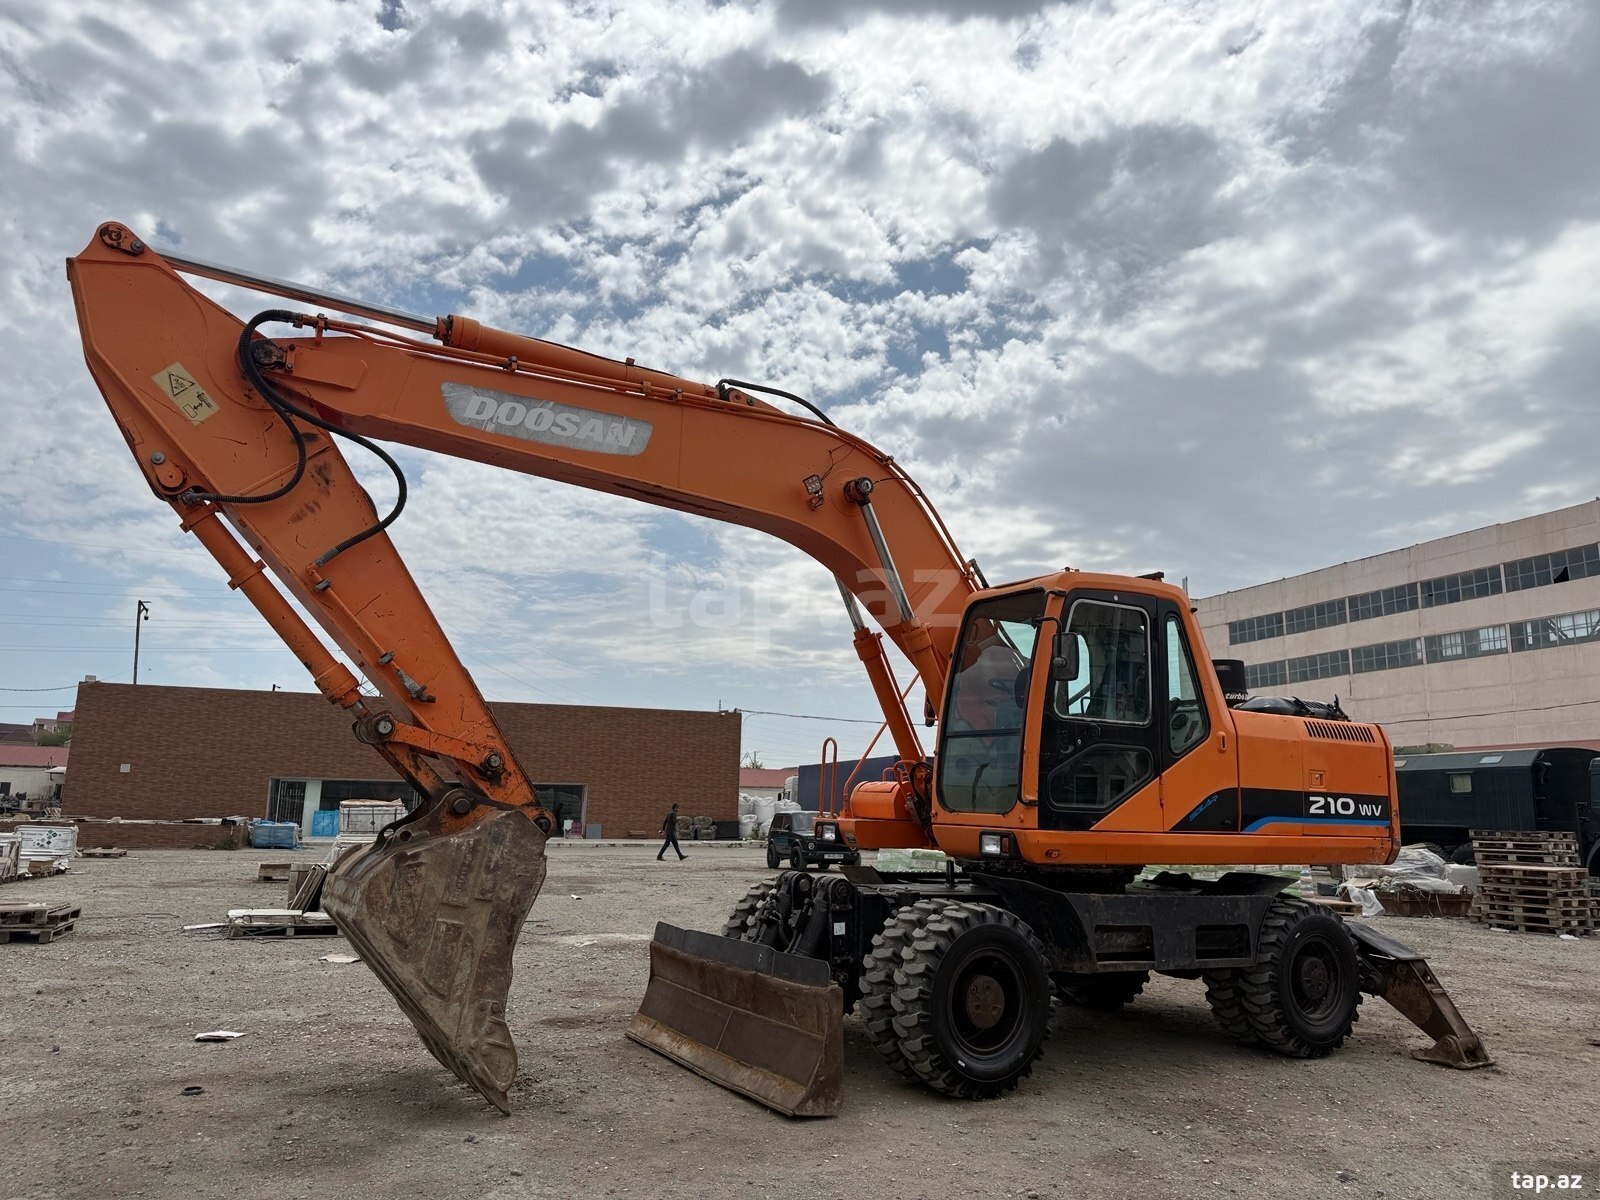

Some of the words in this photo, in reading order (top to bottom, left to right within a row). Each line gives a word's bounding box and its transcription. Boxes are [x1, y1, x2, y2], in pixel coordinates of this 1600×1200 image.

[463, 395, 638, 447] DOOSAN
[1309, 796, 1355, 815] 210
[1358, 804, 1382, 817] WV
